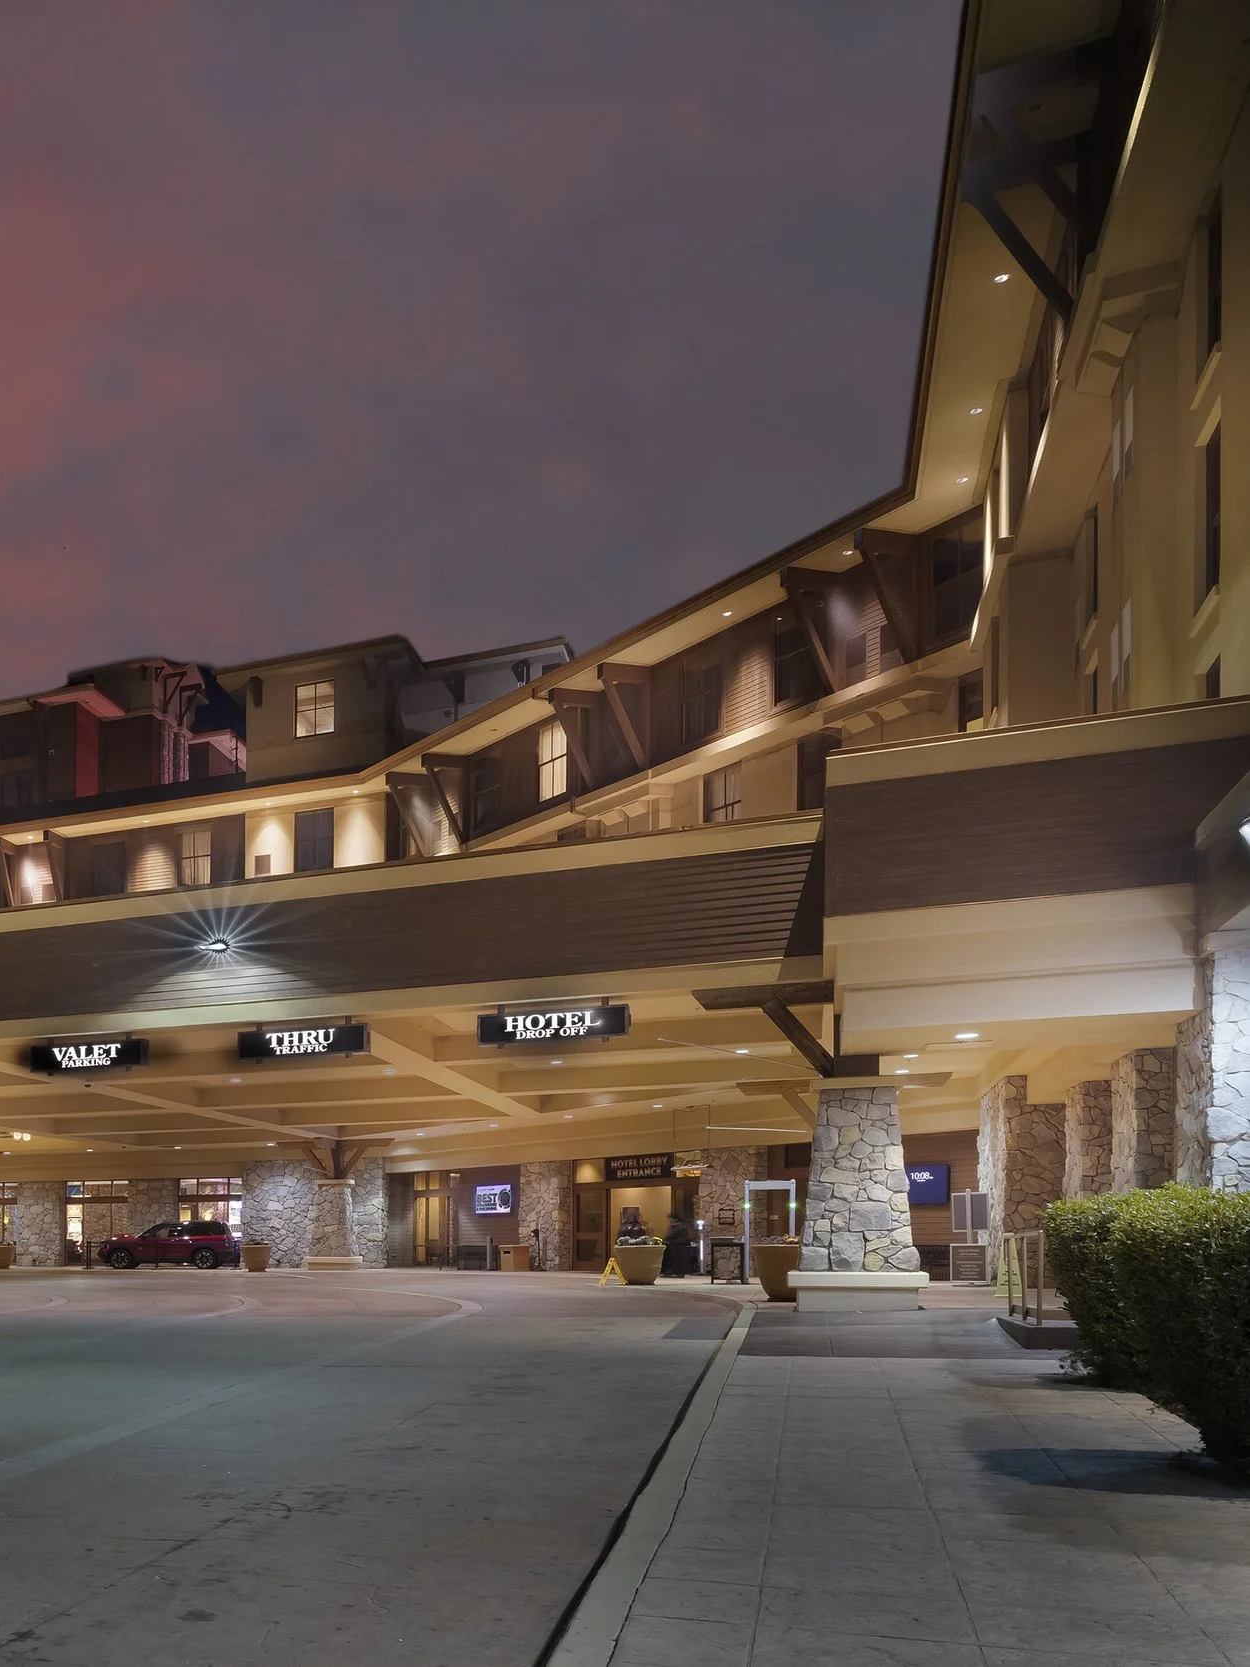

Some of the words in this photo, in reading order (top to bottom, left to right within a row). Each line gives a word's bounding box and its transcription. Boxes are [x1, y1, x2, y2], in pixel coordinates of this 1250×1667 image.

[504, 1011, 601, 1032] HOTEL
[265, 1028, 335, 1048] THRU
[515, 1028, 555, 1040] DROP
[559, 1026, 588, 1037] OFF
[52, 1043, 121, 1061] VALET
[274, 1043, 328, 1055] TRAFFIC
[61, 1057, 111, 1068] PARKING
[611, 1158, 638, 1169] HOTEL
[640, 1156, 668, 1167] LOBBY
[617, 1167, 662, 1178] ENTRANCE
[477, 1193, 498, 1203] BEST
